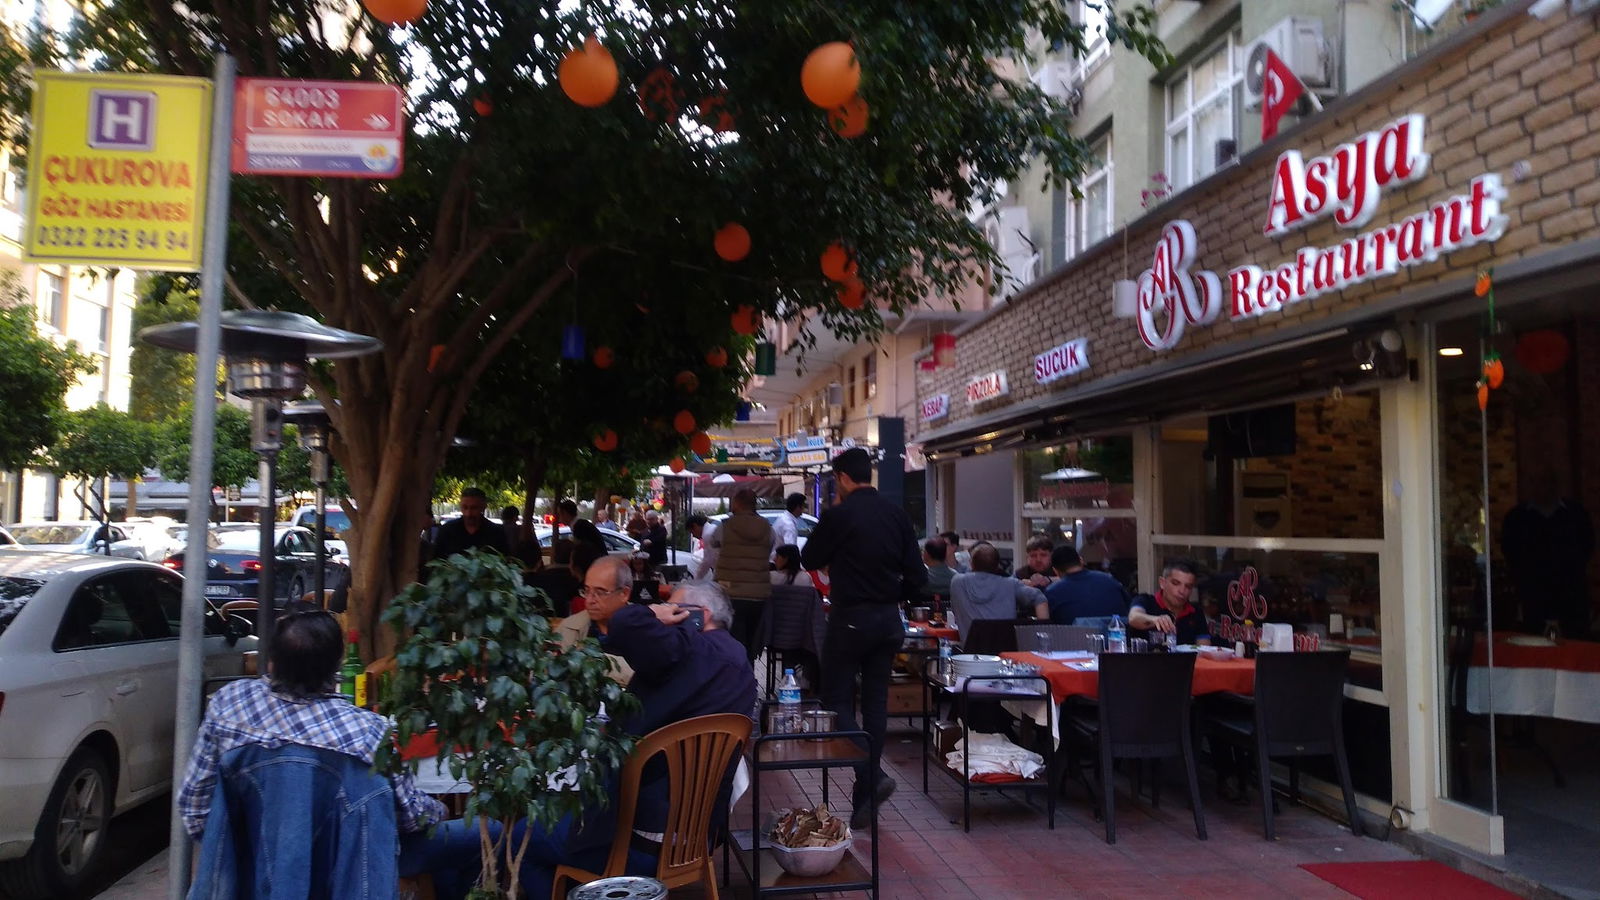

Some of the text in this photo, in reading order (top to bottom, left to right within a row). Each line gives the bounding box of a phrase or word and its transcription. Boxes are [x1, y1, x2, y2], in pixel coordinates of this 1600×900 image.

[101, 98, 144, 141] H
[263, 109, 339, 130] SOKAK
[43, 154, 193, 190] ÇUKUROVA
[1263, 114, 1428, 234] Asya
[40, 191, 81, 217] GÖZ
[38, 224, 190, 250] 0322 225 94 94
[1228, 174, 1507, 320] Restaurant
[1035, 344, 1081, 380] SUCUK
